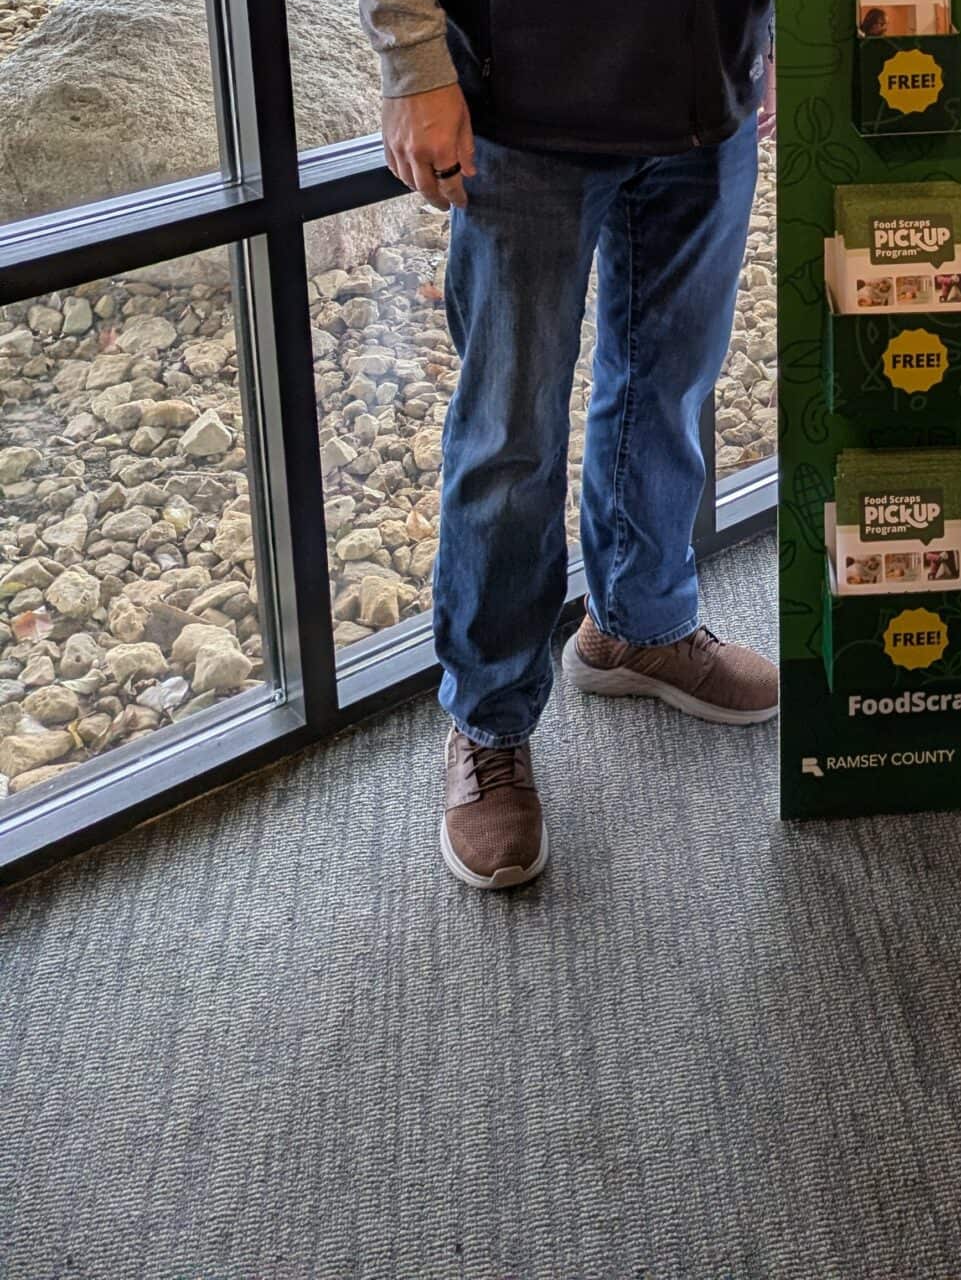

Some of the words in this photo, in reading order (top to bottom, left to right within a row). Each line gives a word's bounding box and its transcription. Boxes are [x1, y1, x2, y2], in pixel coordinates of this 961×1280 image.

[888, 73, 935, 90] FREE!
[874, 220, 897, 229] Food
[899, 220, 930, 229] Scraps
[892, 353, 940, 369] FREE!
[865, 496, 887, 505] Food
[889, 496, 920, 504] Scraps
[893, 631, 941, 647] FREE!
[826, 753, 888, 769] RAMSEY
[891, 749, 956, 766] COUNTY
